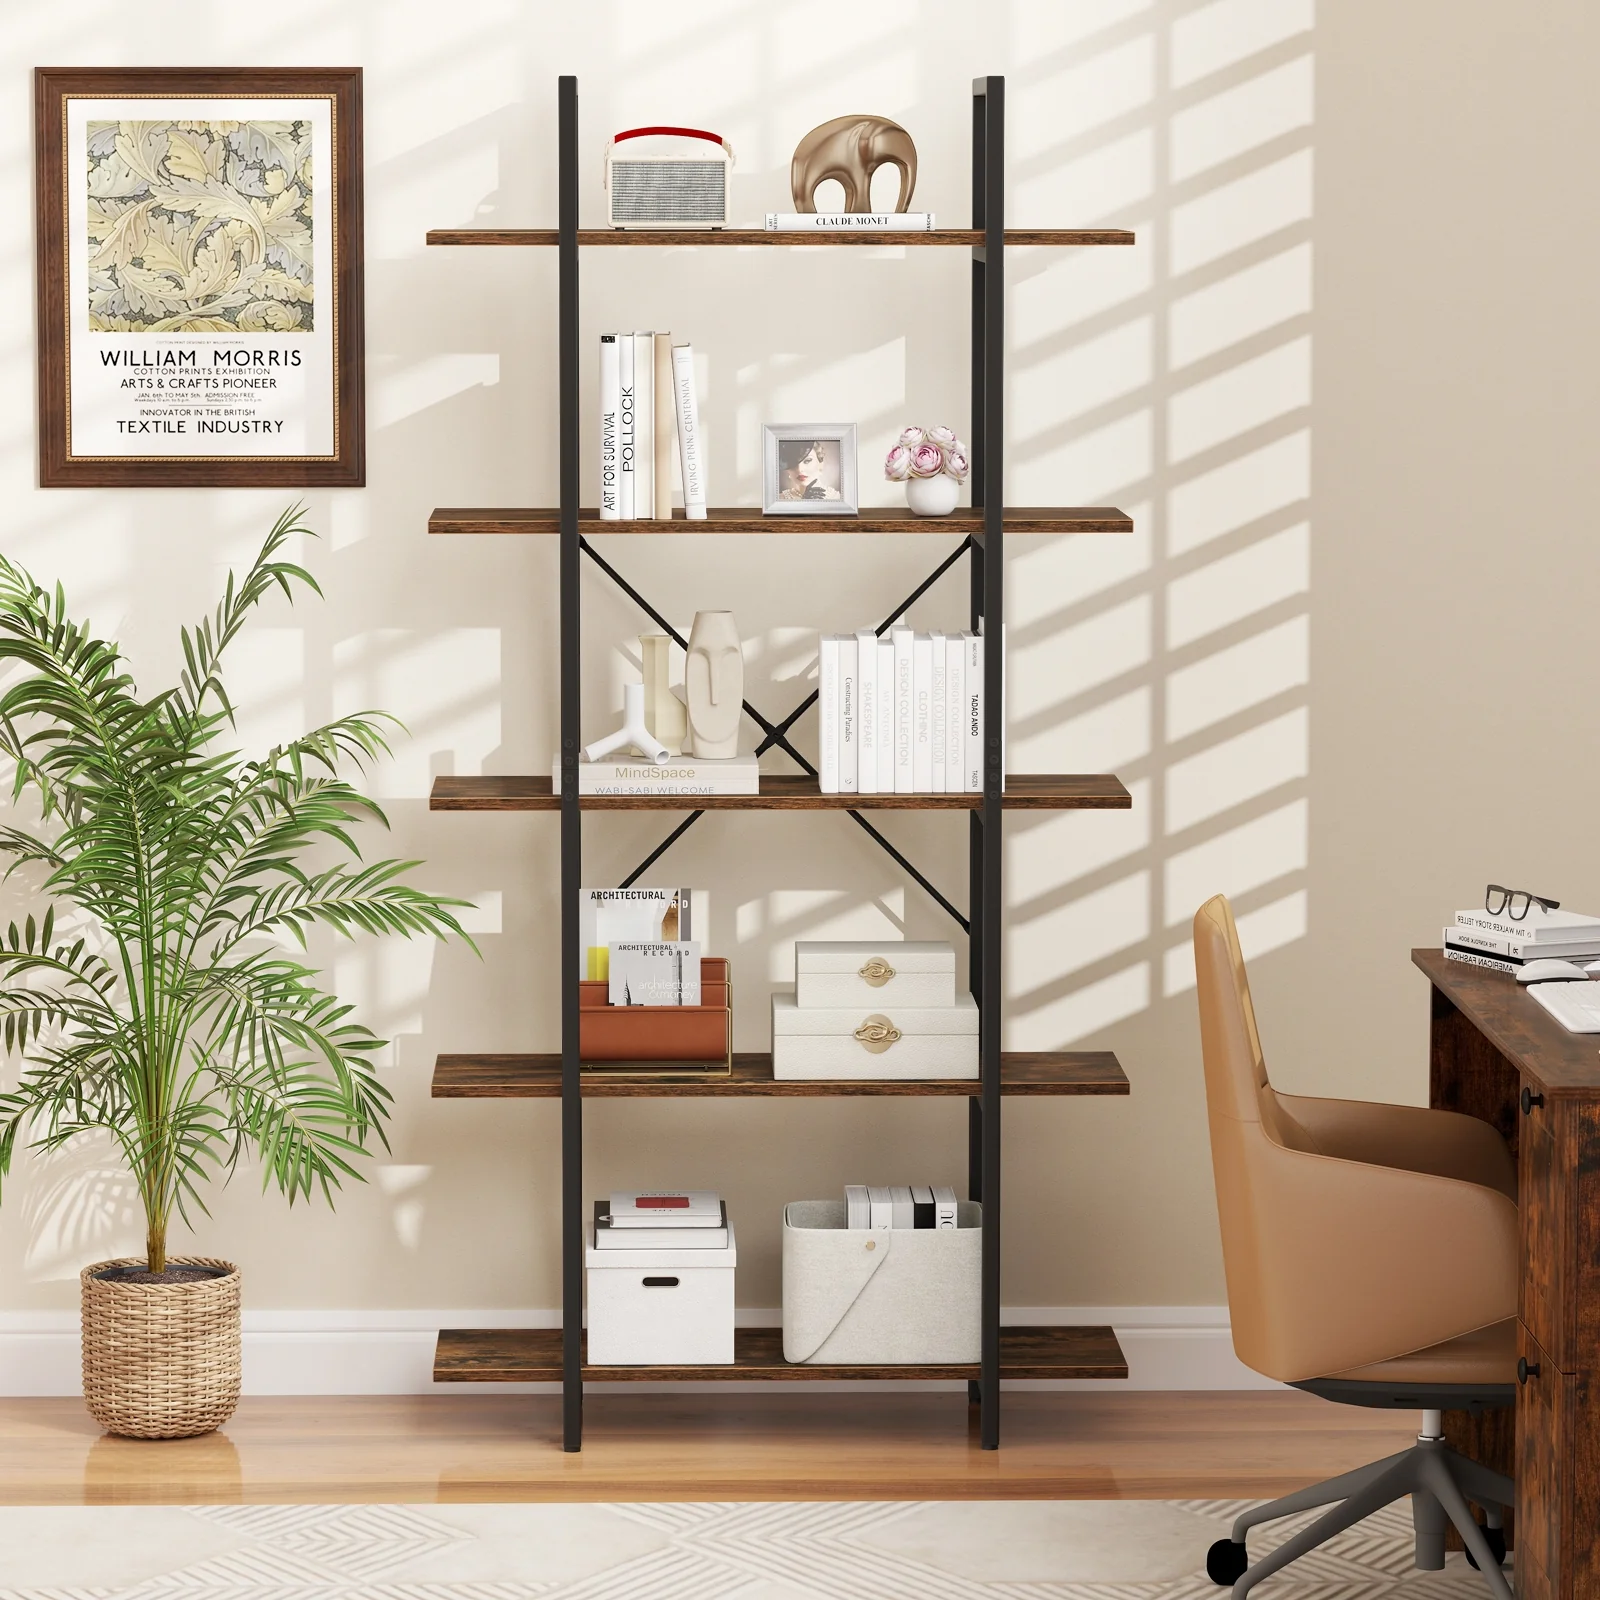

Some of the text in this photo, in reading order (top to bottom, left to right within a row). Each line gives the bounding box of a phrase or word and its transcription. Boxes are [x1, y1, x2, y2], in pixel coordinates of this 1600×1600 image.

[815, 216, 889, 226] CLAUDE MONET
[100, 350, 302, 367] WILLIAM MORRIS
[120, 378, 277, 389] ARTS & CRAFTS PIONEER
[116, 420, 284, 433] TEXTILE INDUSTRY
[140, 408, 256, 416] INNOVATOR IN THE BRITISH
[621, 386, 634, 472] POLLOCK
[681, 377, 699, 496] IRVING PENN: CENTENNIAL
[603, 412, 615, 511] ART FOR SURVIVAL
[843, 677, 853, 716] Constructing
[863, 682, 873, 748] SHAKESPEARE
[899, 658, 909, 767] DESIGN COLLECTION
[933, 666, 944, 764] DESIGN COLLECTION
[971, 694, 979, 737] TADAO ANDO
[918, 690, 928, 743] CLOTHING
[951, 668, 960, 766] DESIGN COLLECTION
[594, 786, 715, 794] WABI-SABI WELCOME
[615, 767, 696, 780] MindSpace
[590, 891, 666, 900] ARCHITECTURAL
[638, 974, 698, 990] architecture
